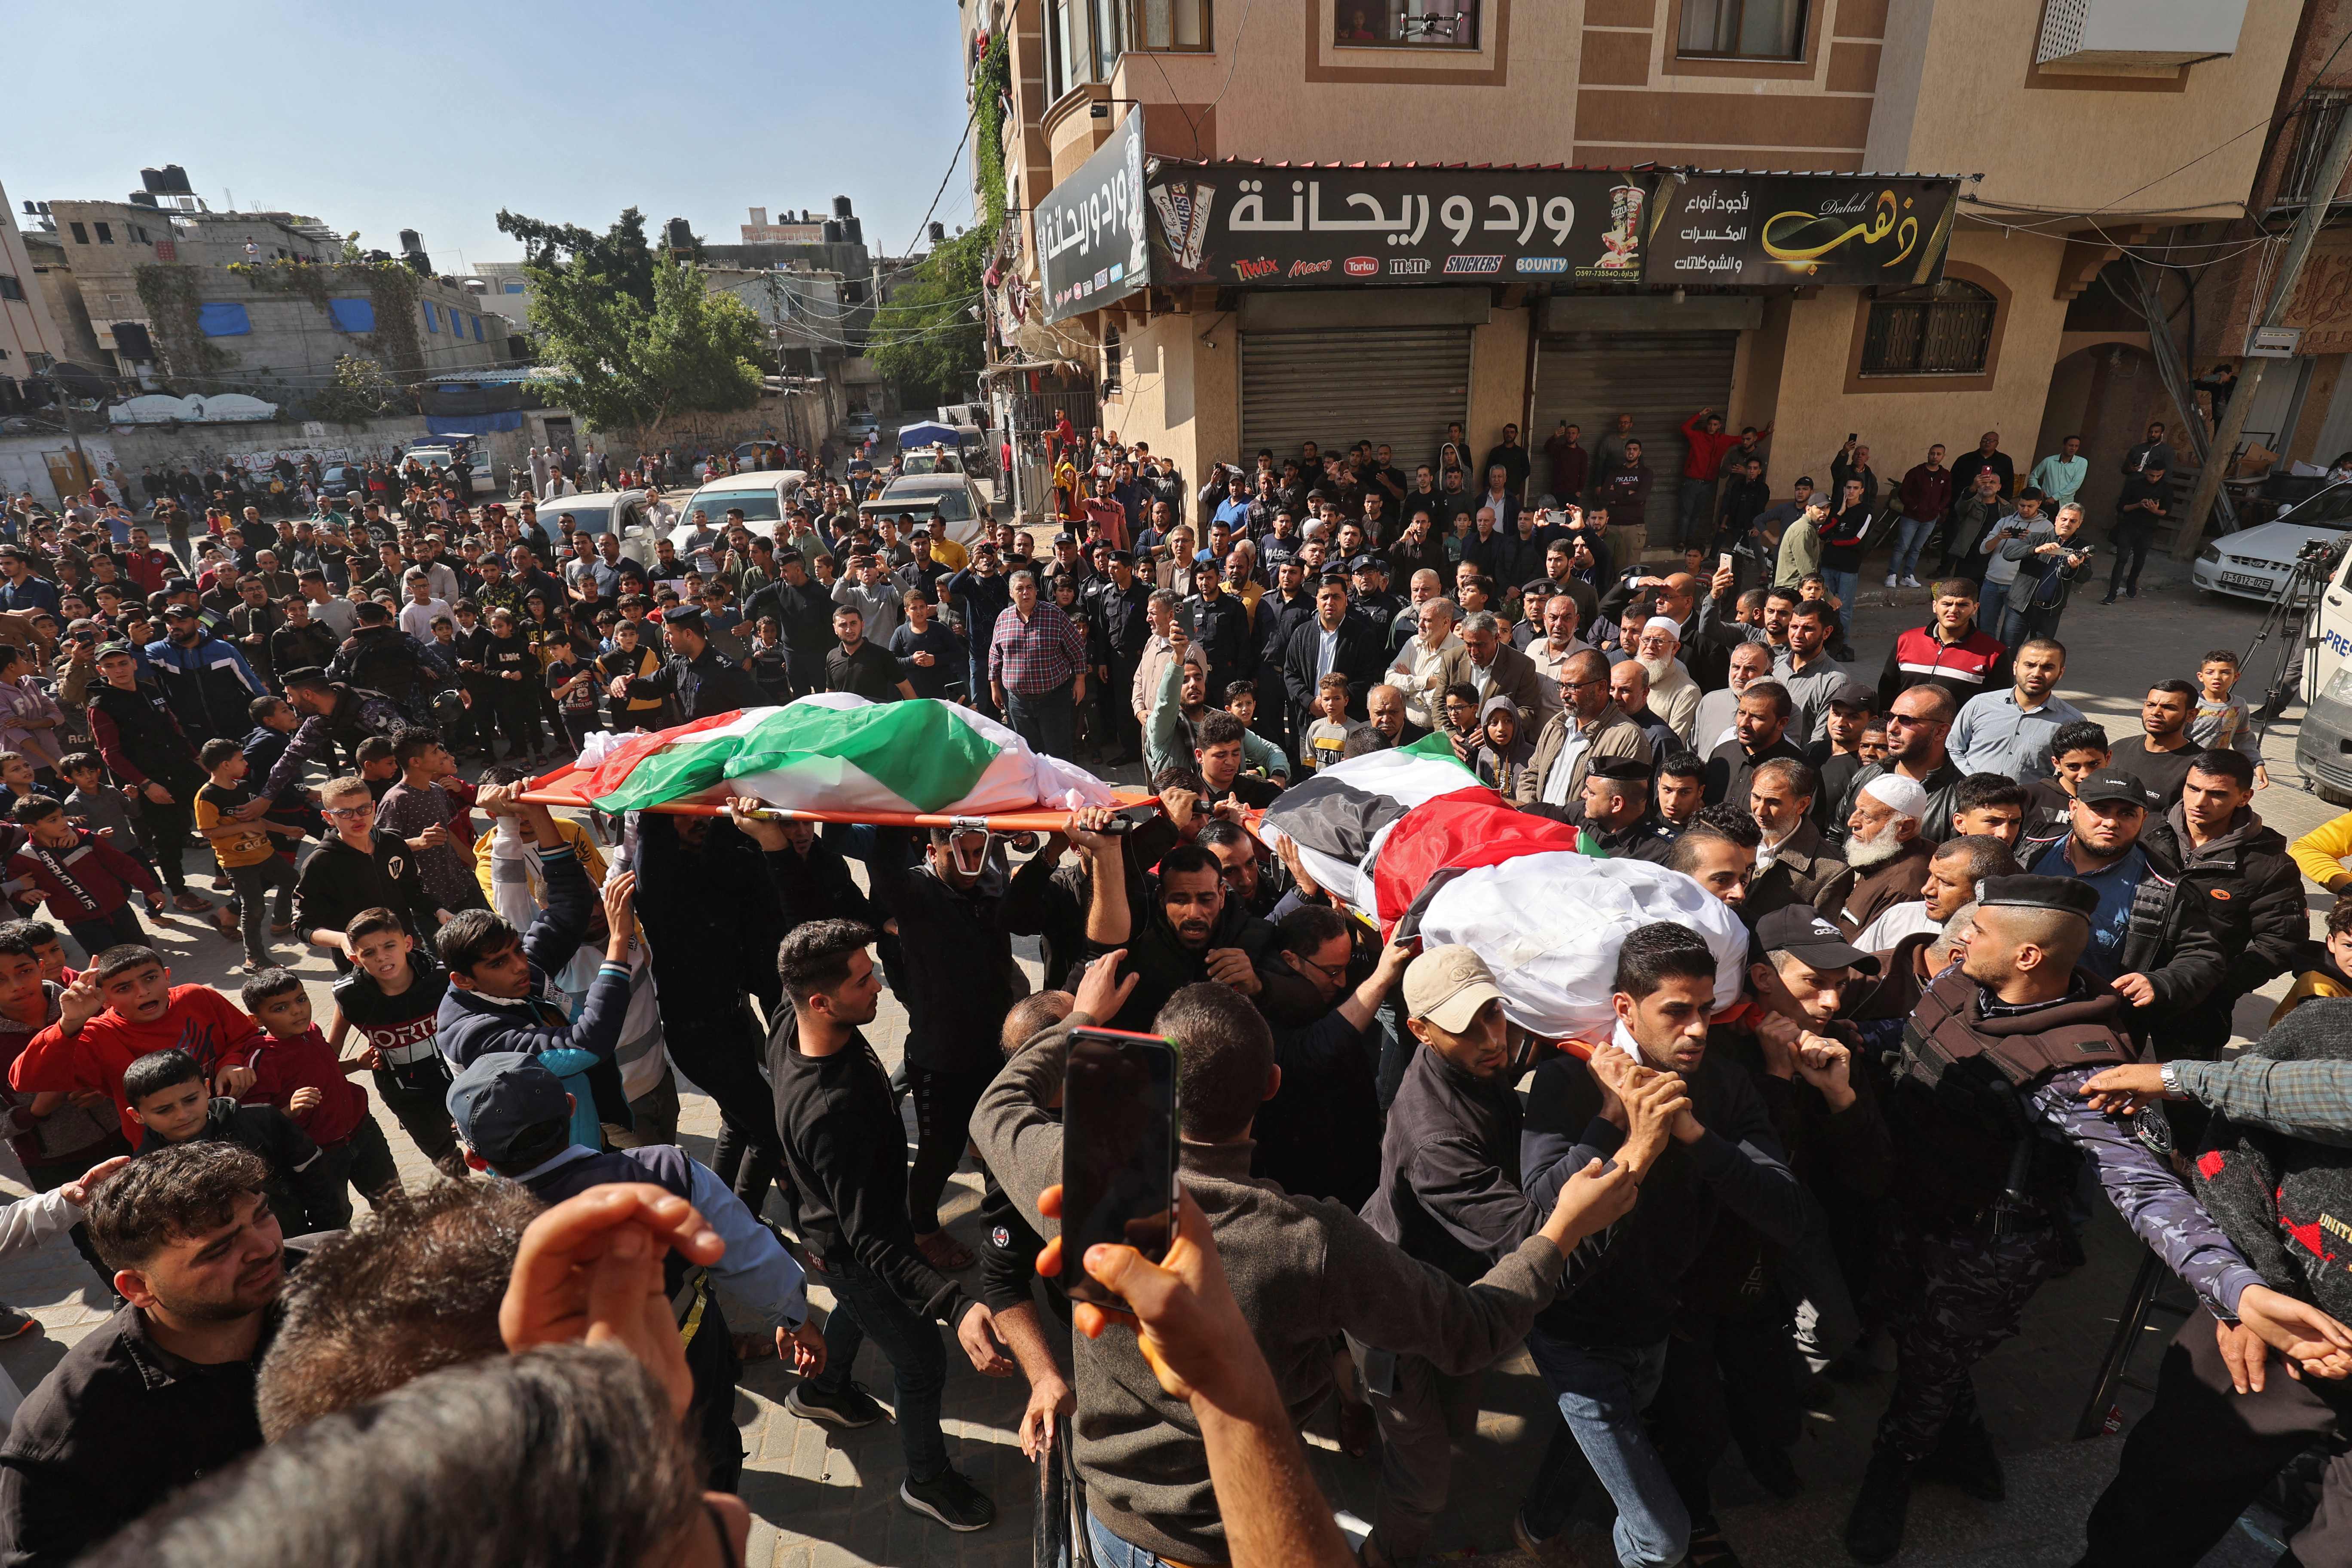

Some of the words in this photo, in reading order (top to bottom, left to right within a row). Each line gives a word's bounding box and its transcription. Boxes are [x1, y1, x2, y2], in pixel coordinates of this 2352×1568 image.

[1685, 190, 1718, 214] أنواع
[1717, 191, 1750, 214] لأجود
[1818, 191, 1874, 215] Dahab
[1483, 195, 1575, 246] ورد
[1680, 225, 1747, 244] المكسرات
[1762, 189, 1918, 276] ذهب
[1288, 259, 1332, 278] Mars
[1348, 261, 1375, 271] Torku
[1445, 257, 1502, 272] SNICKERS
[1516, 258, 1567, 271] BOUNTY
[1090, 502, 1121, 514] UNCLE
[39, 850, 73, 886] BRAVO
[70, 884, 96, 911] PLUS
